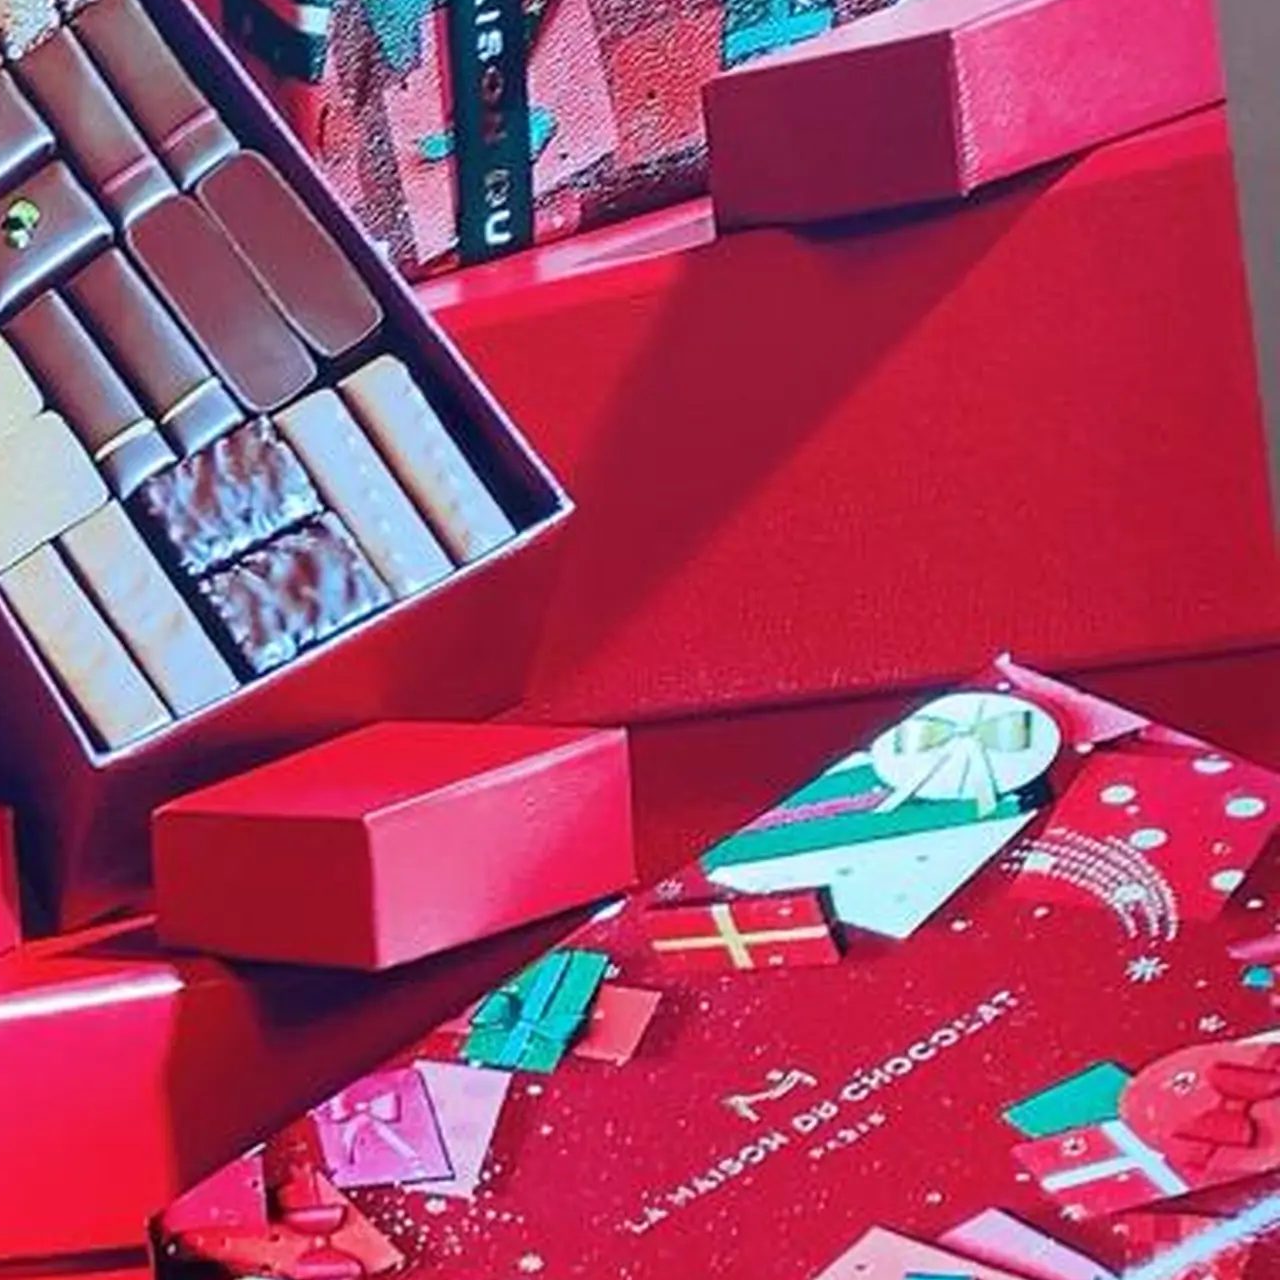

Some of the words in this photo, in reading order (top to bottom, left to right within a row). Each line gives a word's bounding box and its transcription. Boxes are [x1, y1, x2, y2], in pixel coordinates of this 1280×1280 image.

[483, 168, 513, 247] DU
[627, 1206, 669, 1234] LA
[666, 1131, 790, 1209] MAISON
[792, 1100, 839, 1134] DU
[840, 990, 1020, 1104] CHOCOLAT
